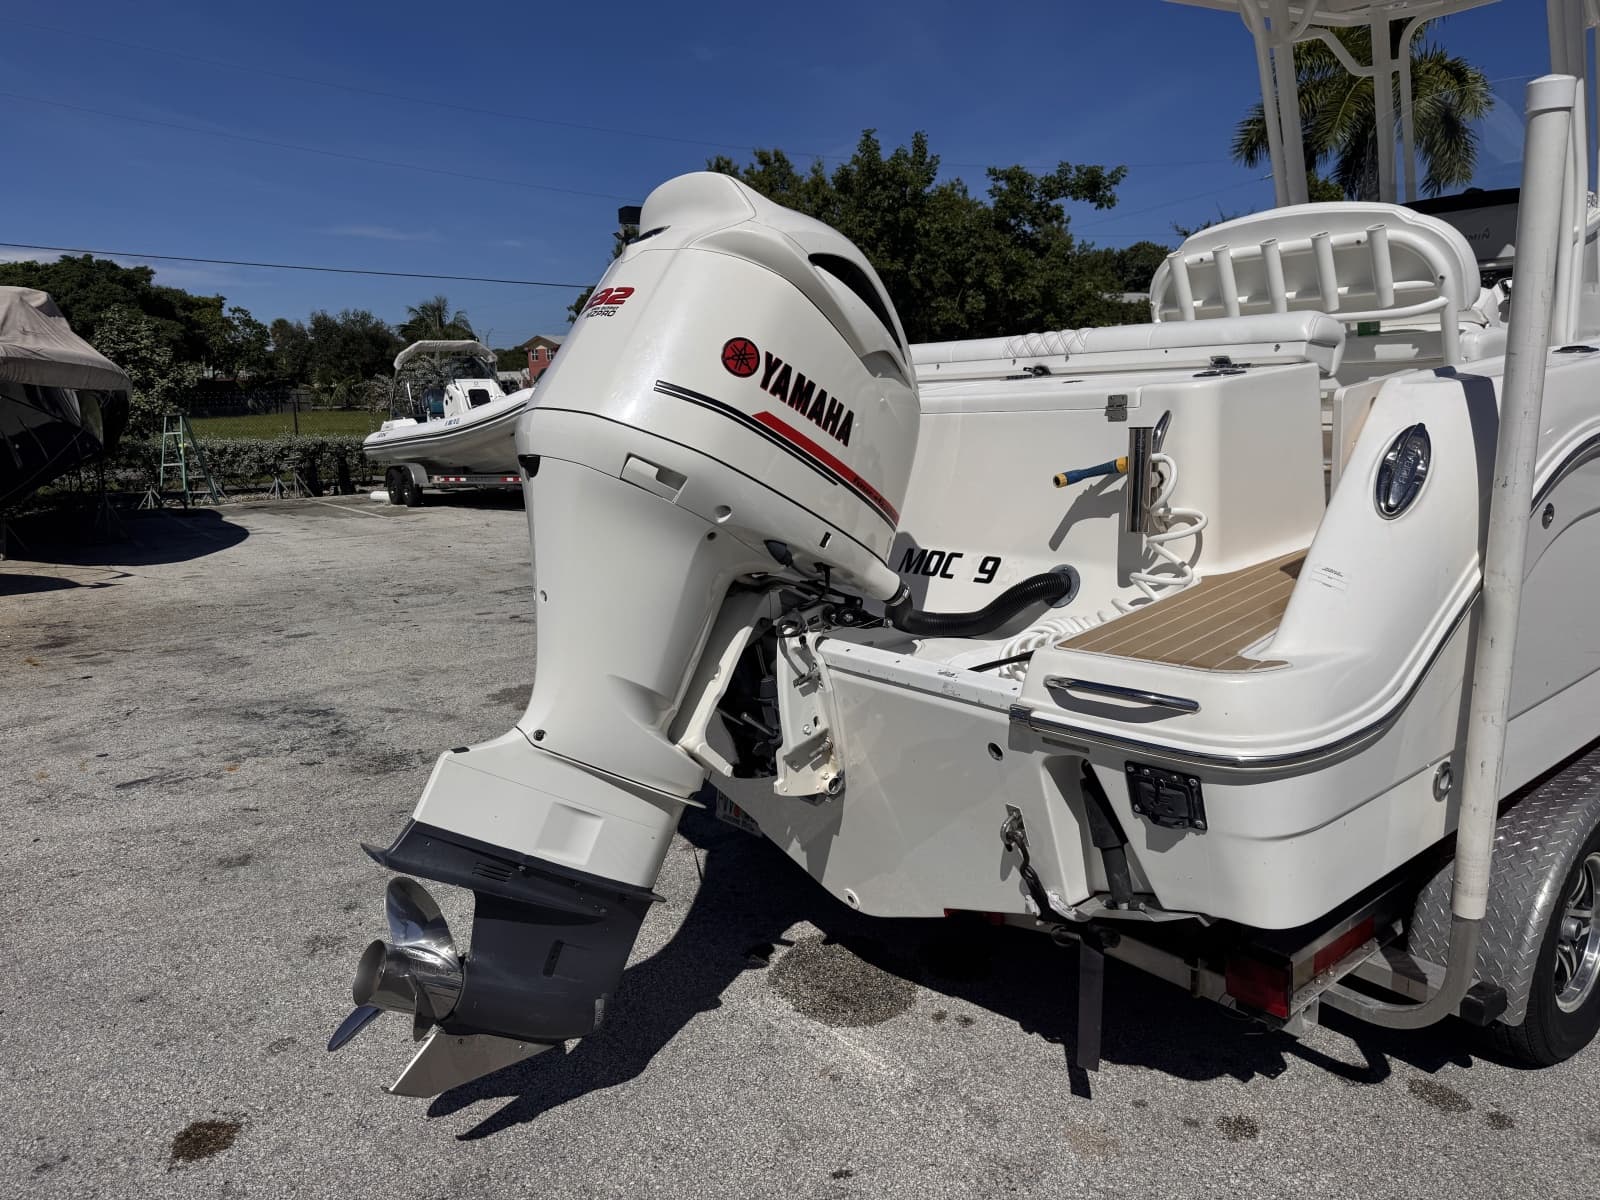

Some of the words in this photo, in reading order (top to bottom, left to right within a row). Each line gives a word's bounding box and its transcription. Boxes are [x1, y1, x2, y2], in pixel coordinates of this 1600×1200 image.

[759, 351, 855, 447] YAMAHA
[898, 548, 964, 579] MOC
[973, 556, 1002, 584] 9
